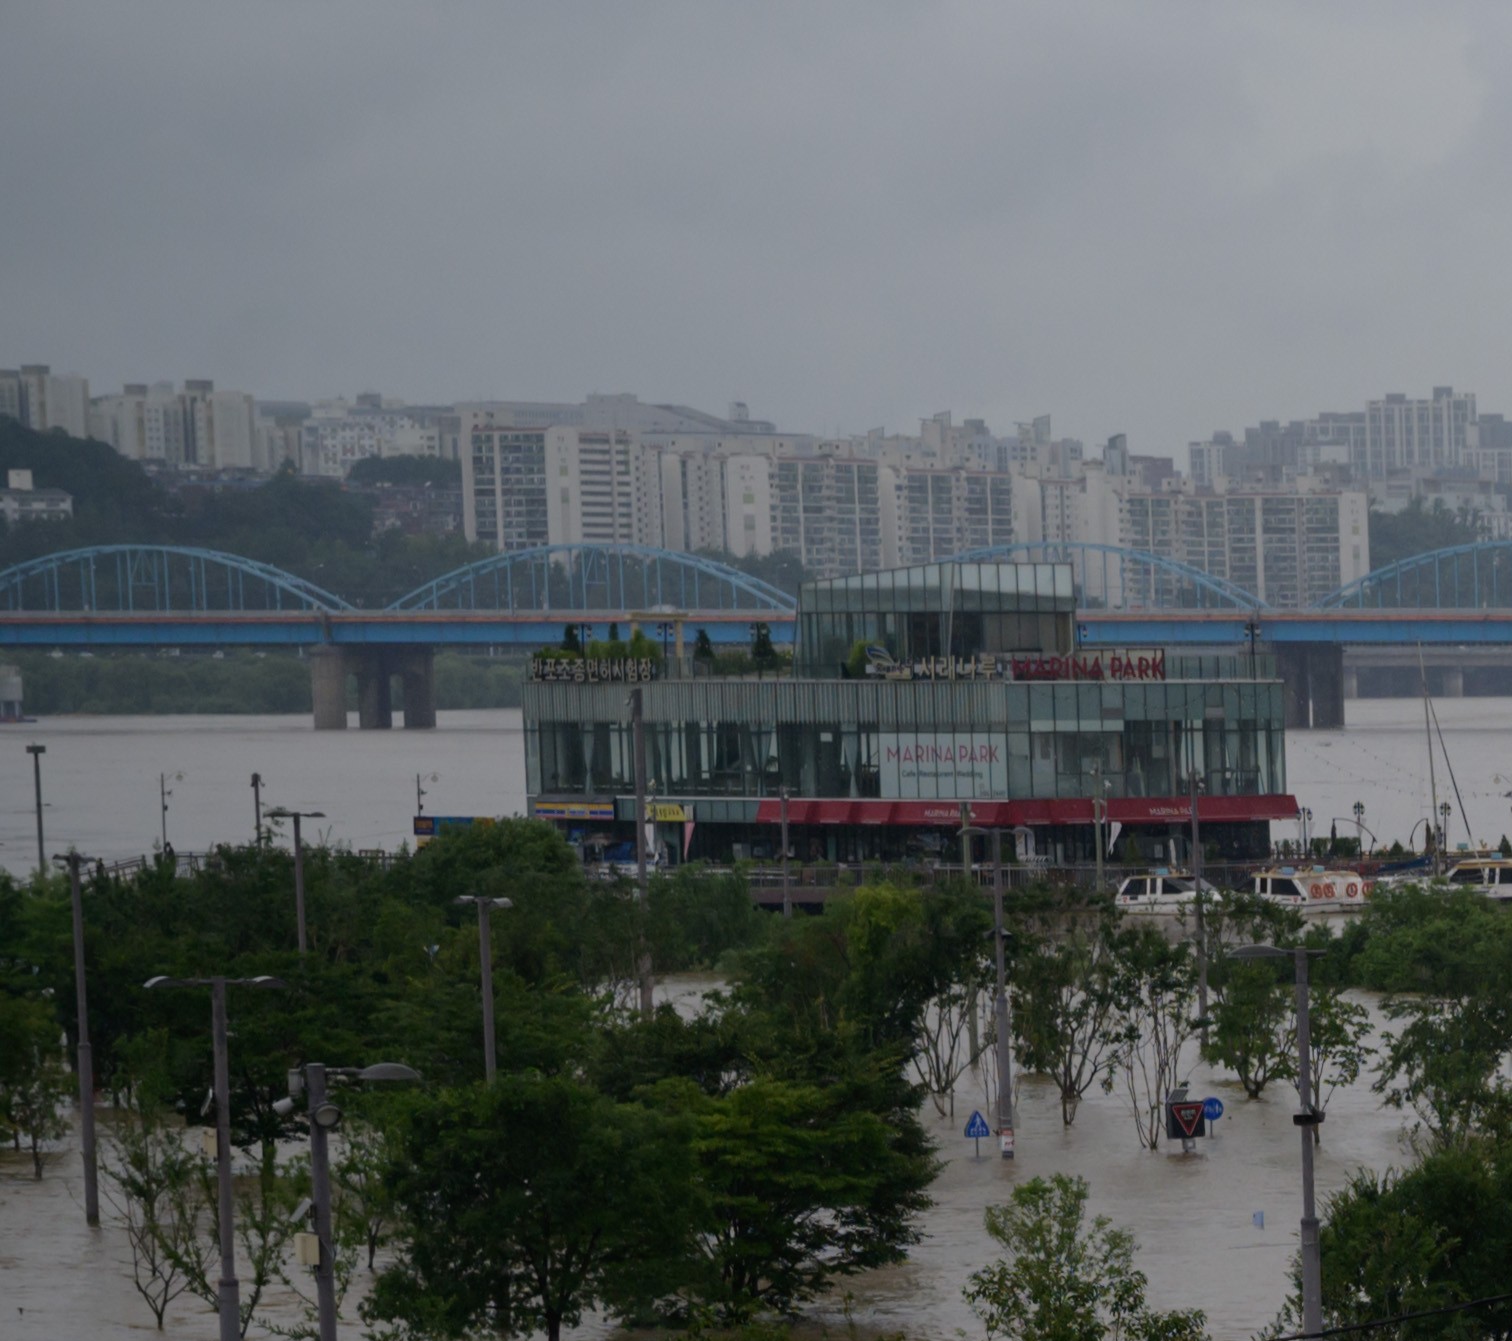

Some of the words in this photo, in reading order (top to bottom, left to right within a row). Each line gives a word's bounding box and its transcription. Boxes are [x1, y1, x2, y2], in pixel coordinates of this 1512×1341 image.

[531, 657, 652, 682] 반포조종면허시험장
[1011, 655, 1107, 681] MARINA
[1109, 655, 1166, 682] PARK
[886, 744, 955, 763] MARINA
[958, 744, 1000, 763] PARK
